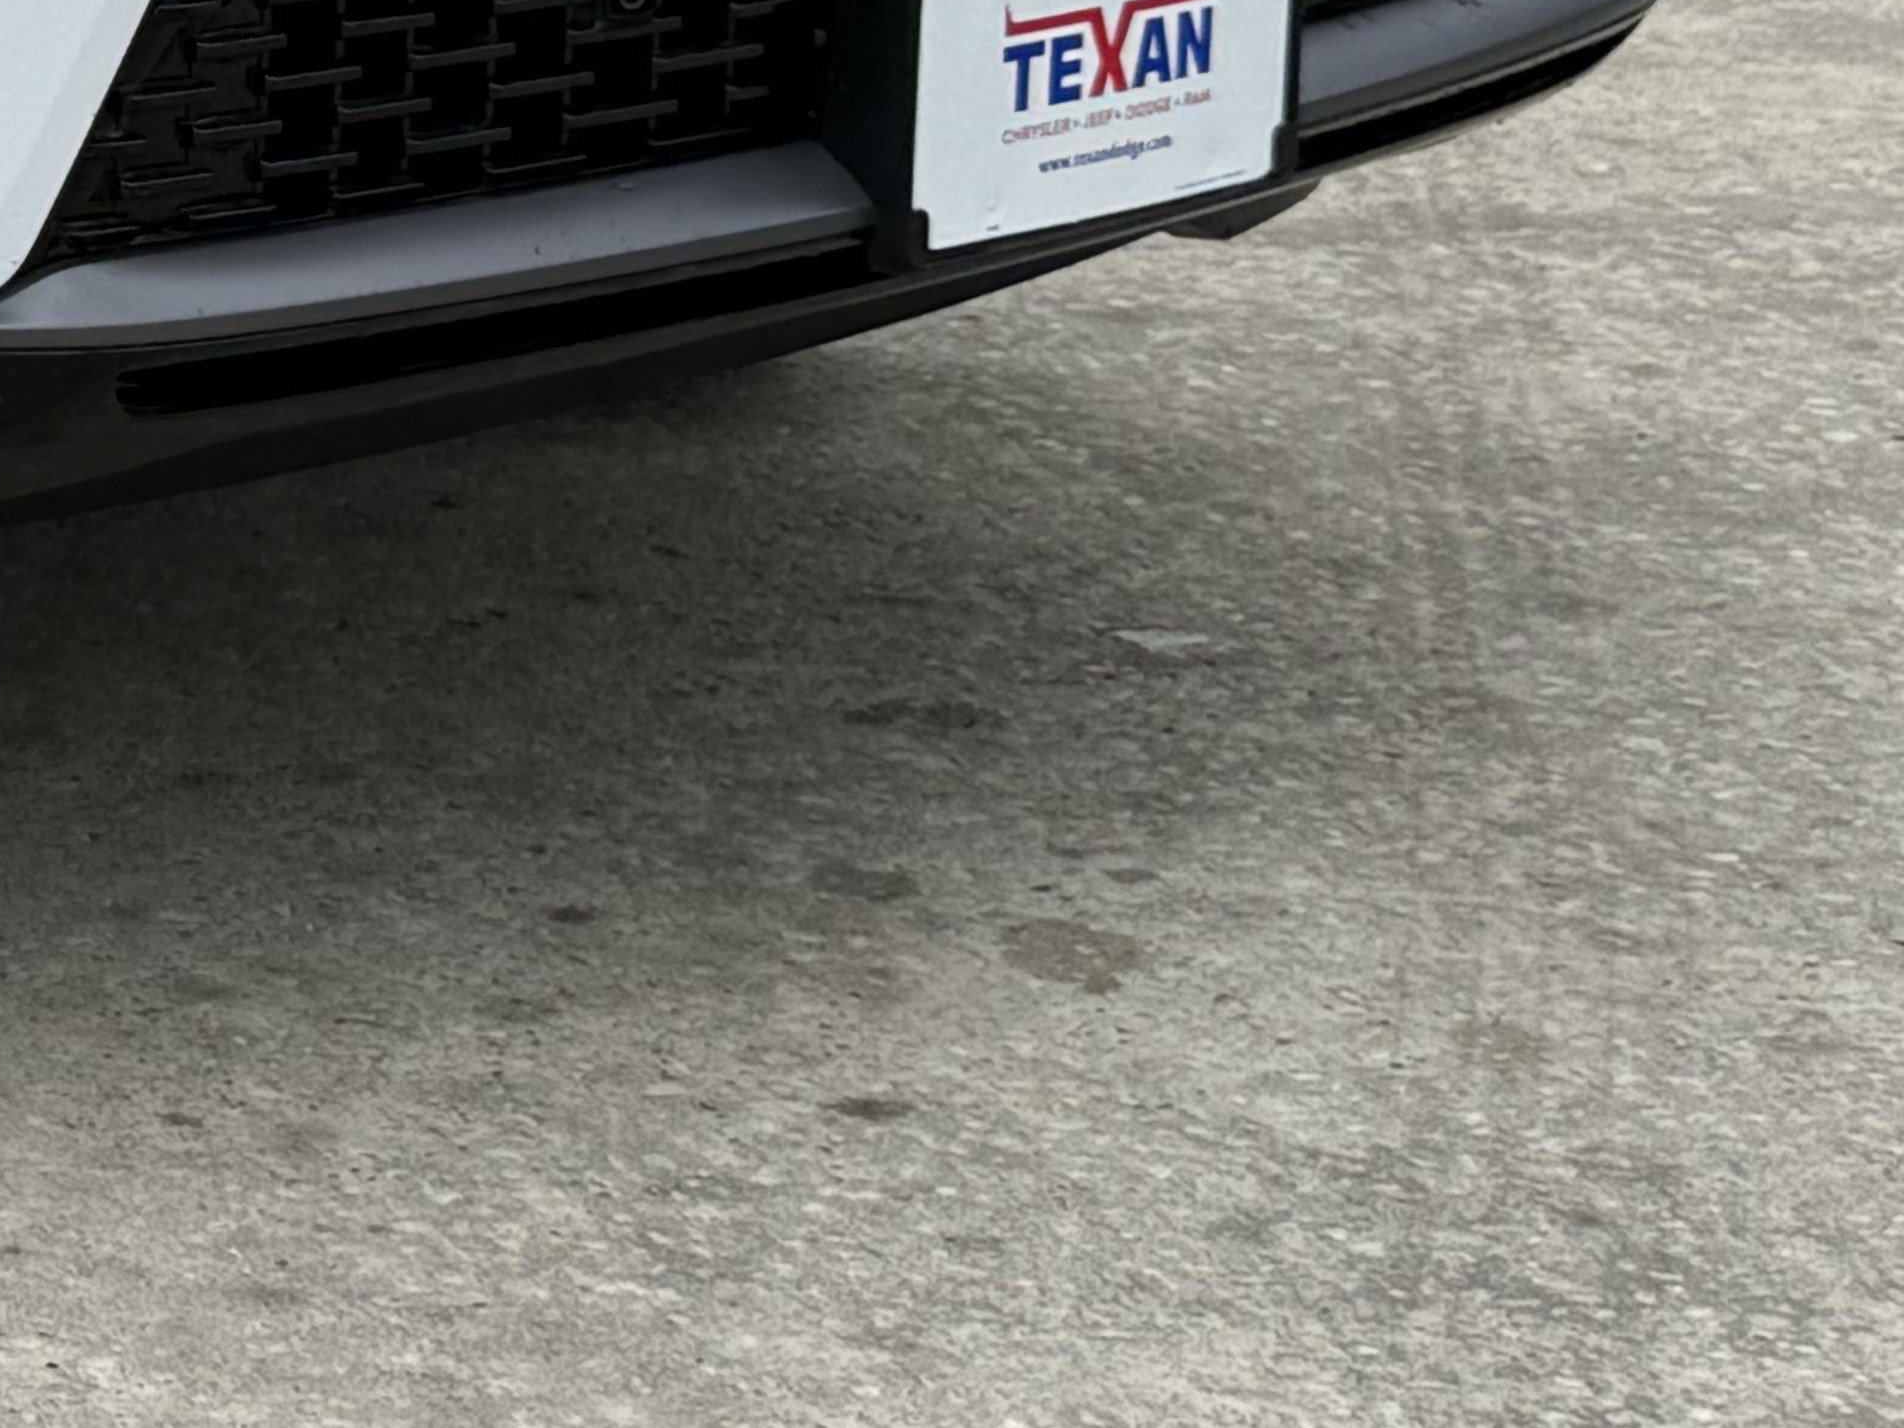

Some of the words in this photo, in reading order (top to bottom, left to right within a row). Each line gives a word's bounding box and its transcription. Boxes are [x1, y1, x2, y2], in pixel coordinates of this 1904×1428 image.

[1003, 6, 1214, 113] TEXAN
[1000, 116, 1071, 145] CHRYSLER
[1125, 95, 1172, 121] DODGE
